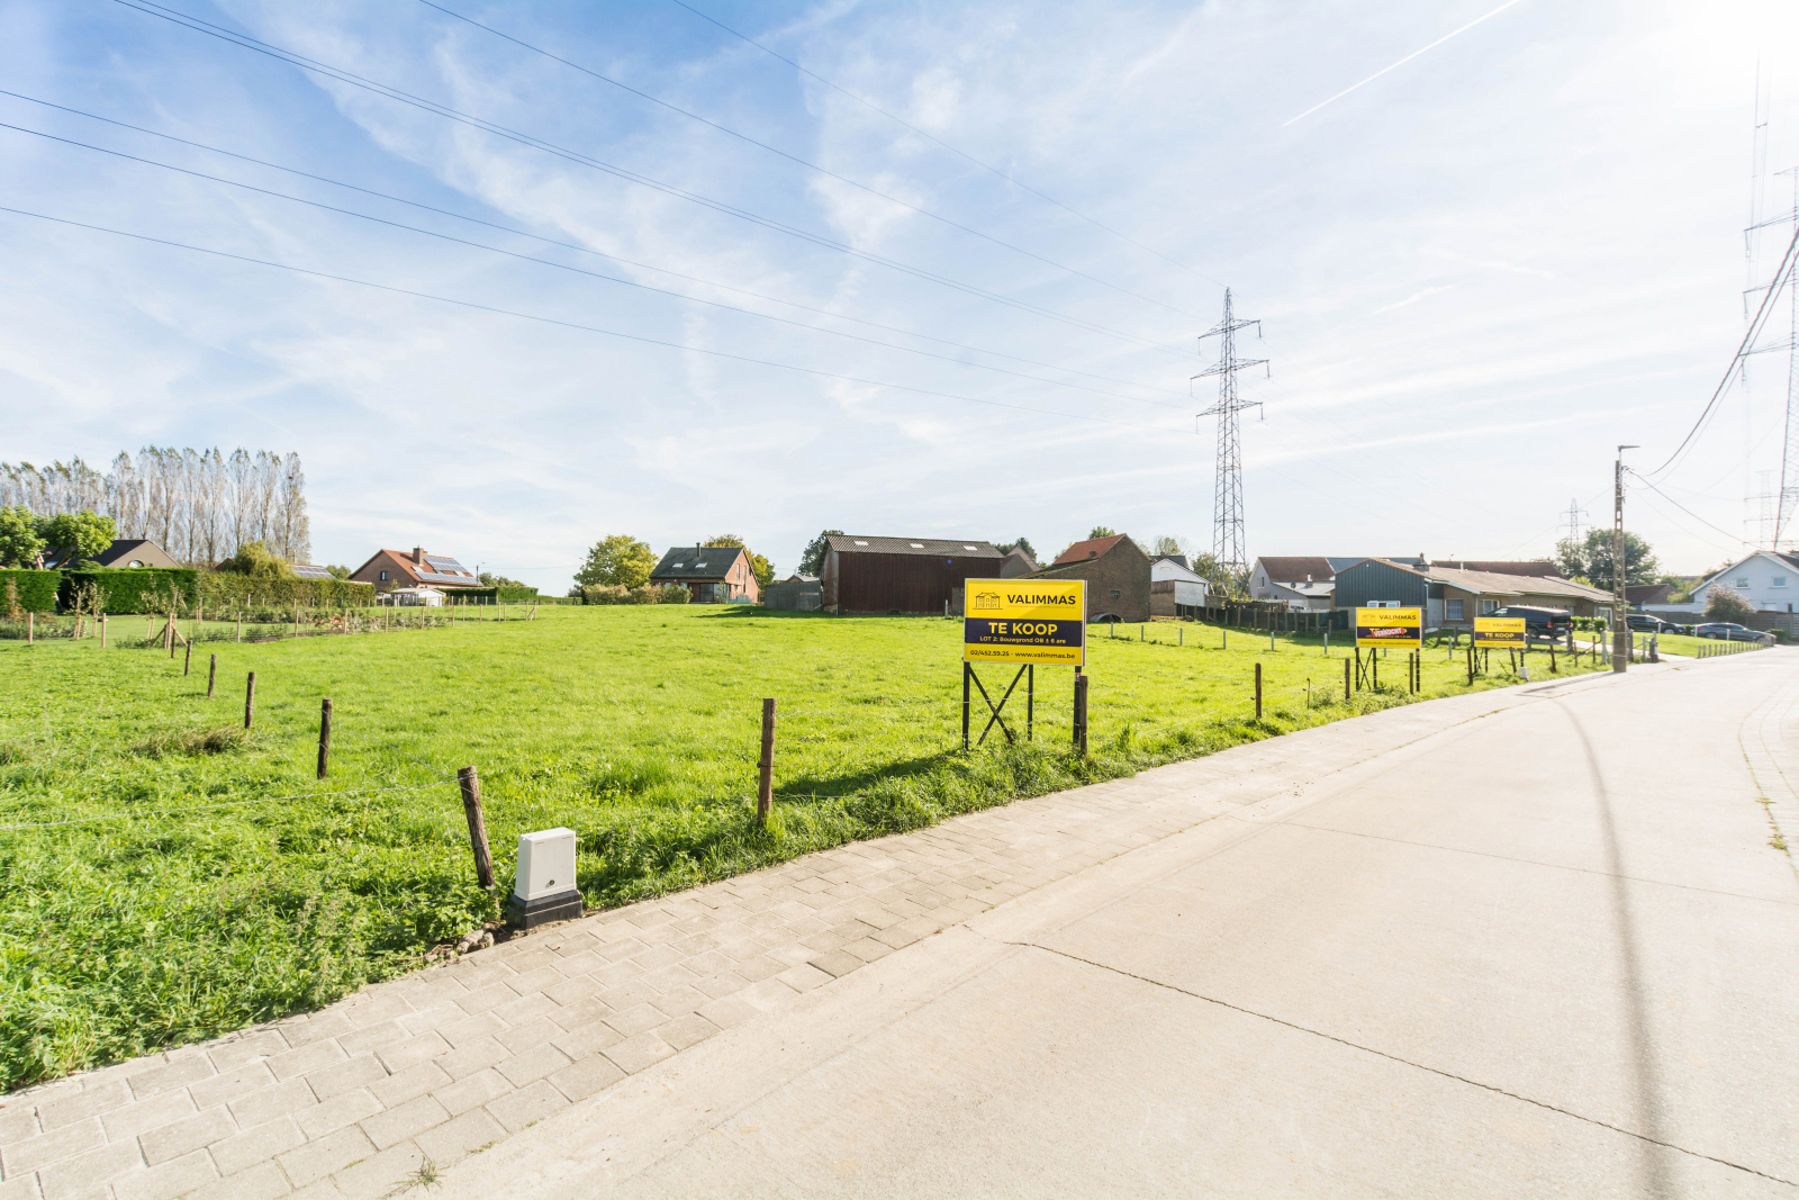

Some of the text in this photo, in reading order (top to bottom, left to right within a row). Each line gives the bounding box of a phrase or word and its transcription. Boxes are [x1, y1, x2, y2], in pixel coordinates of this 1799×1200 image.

[1007, 594, 1076, 605] VALIMMAS
[988, 622, 1058, 635] TE KOOP
